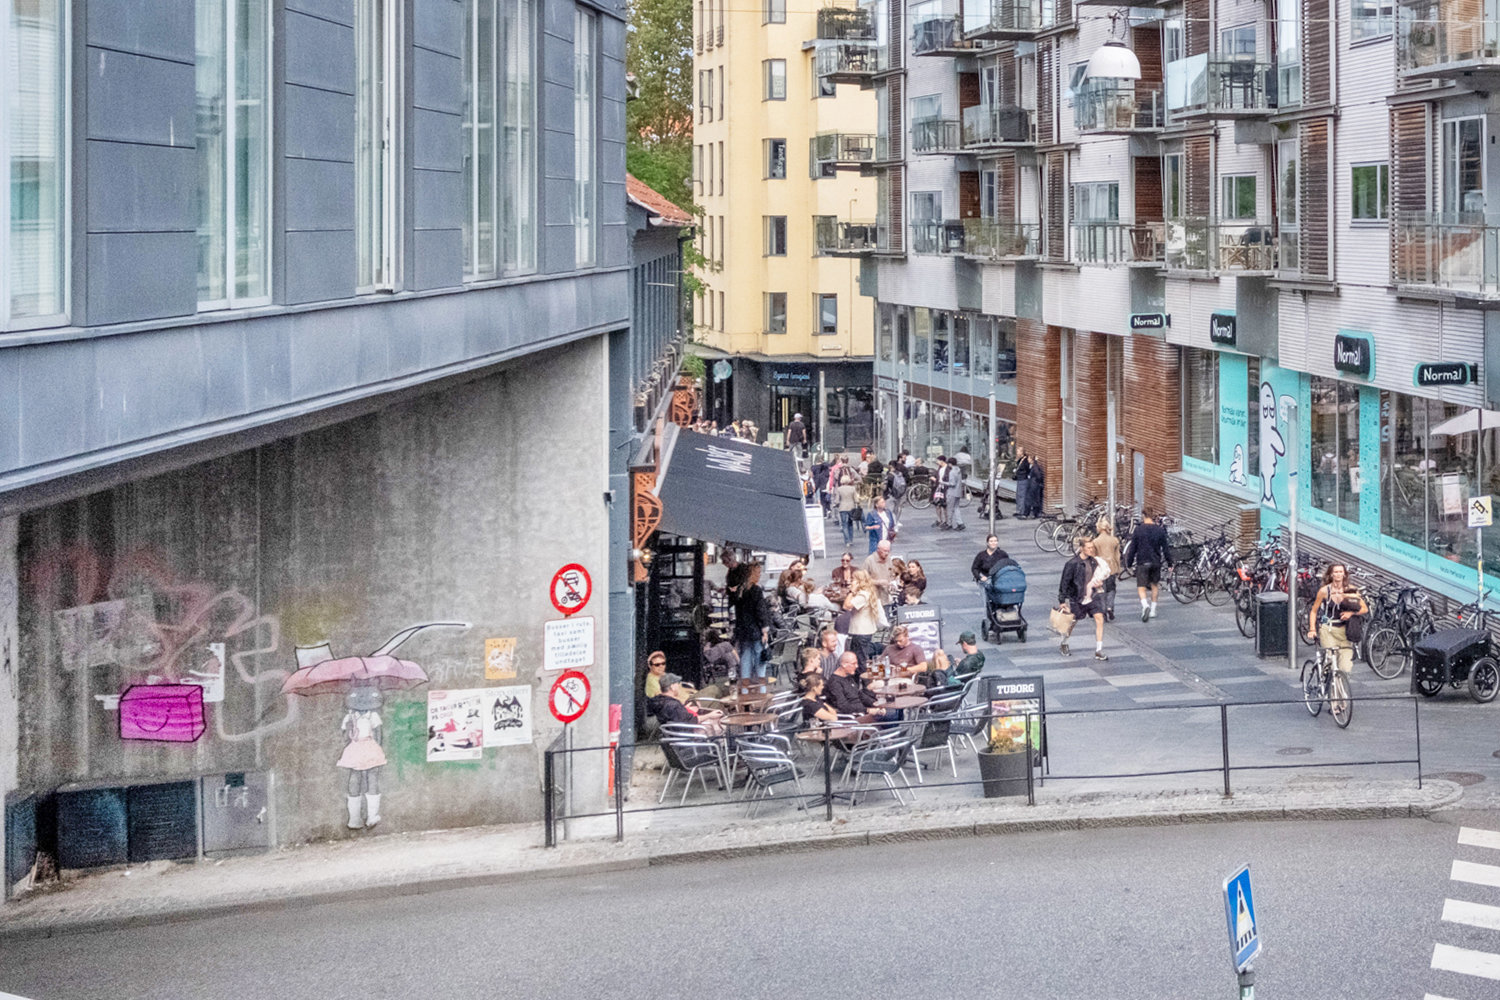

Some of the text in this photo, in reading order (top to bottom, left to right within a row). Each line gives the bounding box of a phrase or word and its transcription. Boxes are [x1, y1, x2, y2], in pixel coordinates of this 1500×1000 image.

[1134, 316, 1161, 327] Normal
[1213, 319, 1233, 338] Normal
[1338, 342, 1361, 365] Normal
[1423, 367, 1462, 382] Normal
[904, 610, 935, 619] TUBORG
[996, 683, 1034, 695] TUBORG
